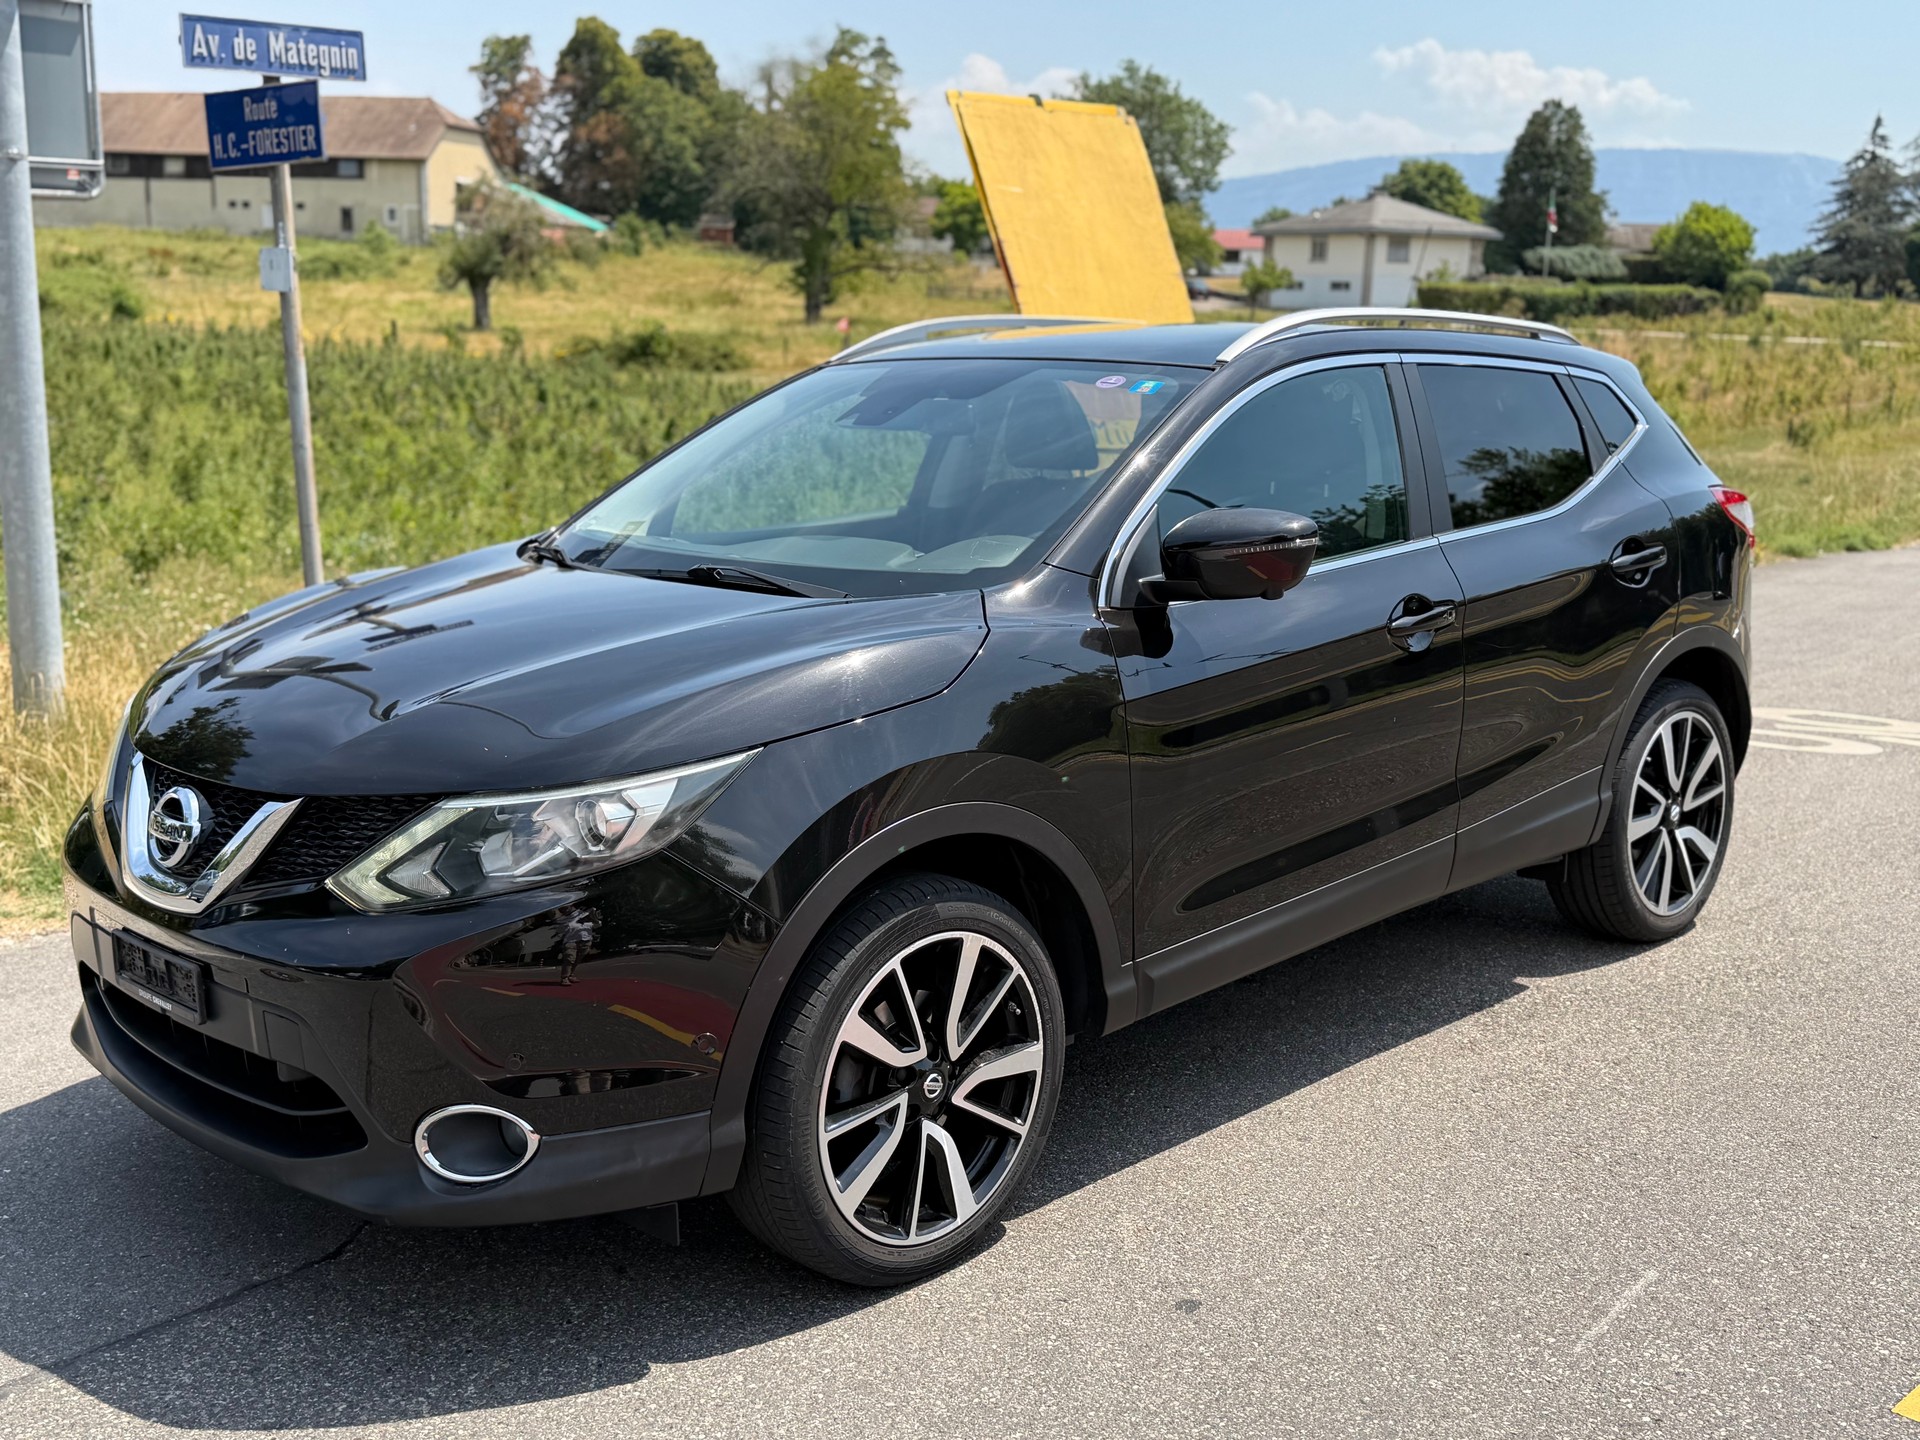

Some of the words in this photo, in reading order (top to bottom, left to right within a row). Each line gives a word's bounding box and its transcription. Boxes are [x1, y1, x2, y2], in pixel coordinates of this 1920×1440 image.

[192, 23, 227, 59] Av.
[233, 27, 257, 61] de
[268, 30, 359, 77] Mategnin
[243, 96, 279, 123] Route
[213, 124, 317, 160] H.C.-FORESTIER
